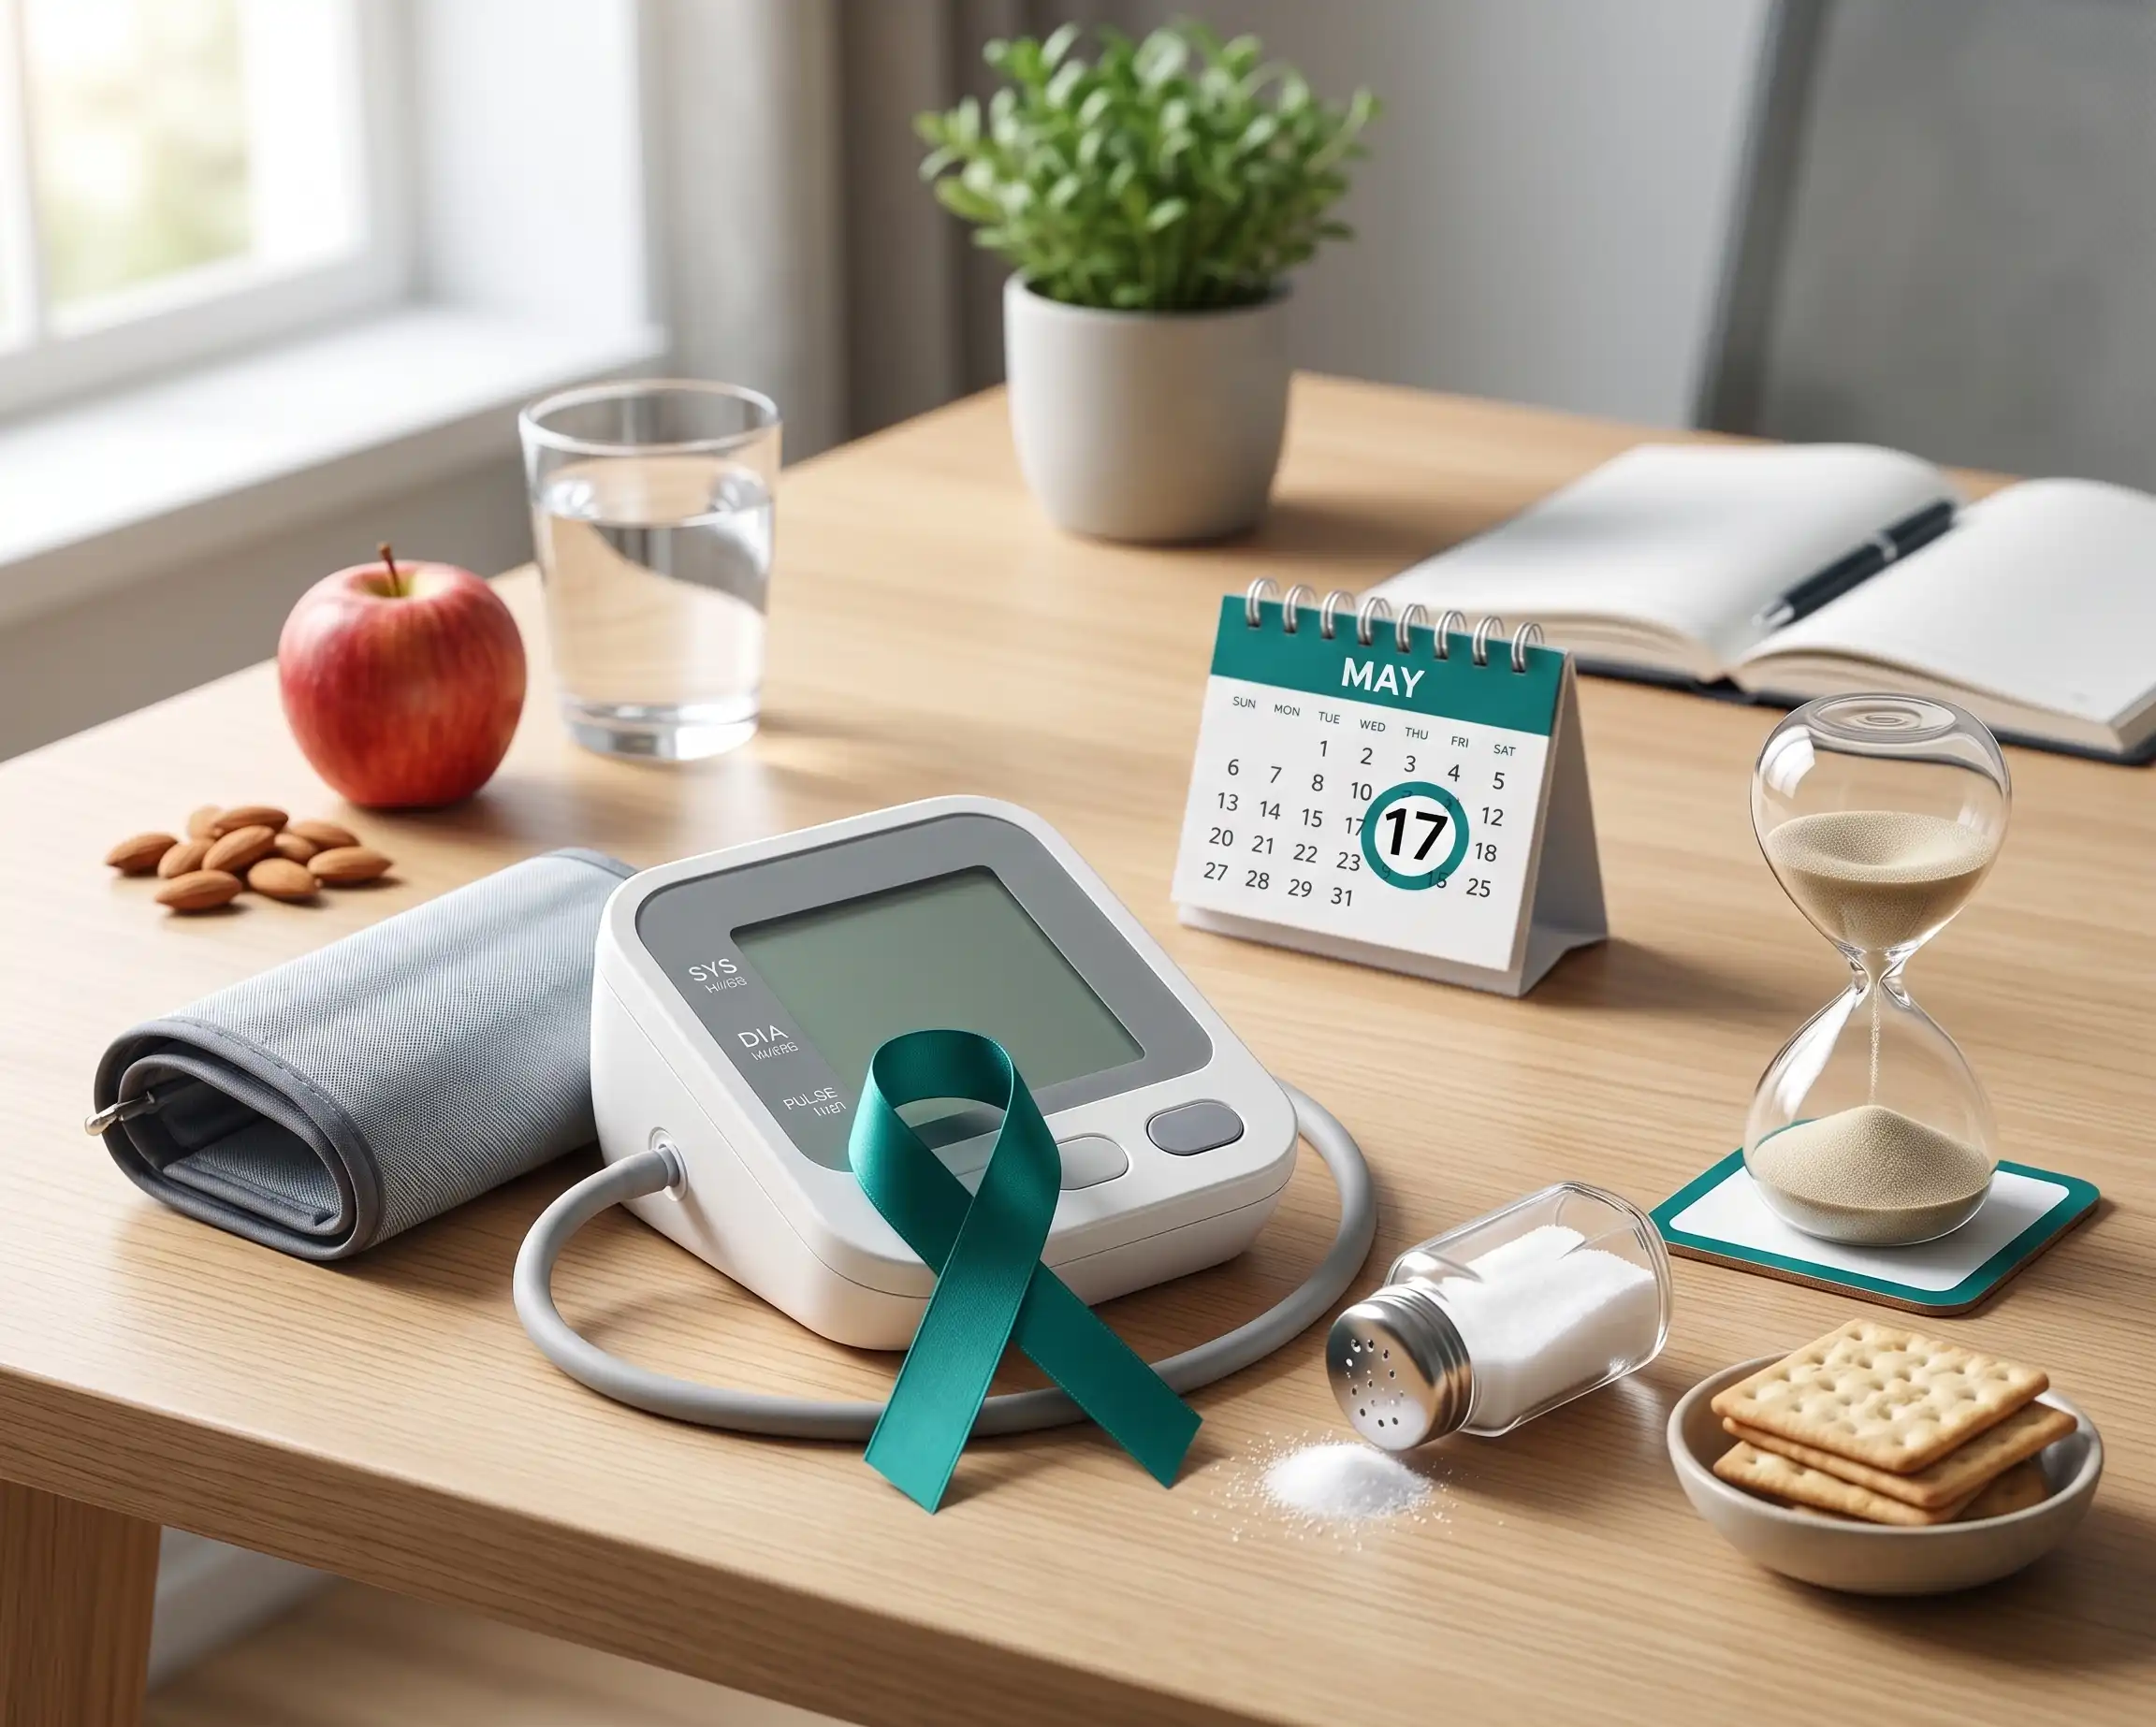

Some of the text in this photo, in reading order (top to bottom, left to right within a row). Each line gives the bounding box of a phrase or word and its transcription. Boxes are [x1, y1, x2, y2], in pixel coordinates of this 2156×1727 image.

[1341, 657, 1425, 698] MAY
[1232, 696, 1517, 757] SUN MON TUE WED THU FRI SAT
[1319, 740, 1506, 791] 1 2 3 4 5
[1228, 759, 1504, 829] 6 7 8 10 12
[1217, 791, 1239, 812] 13
[1260, 800, 1281, 820] 14
[1302, 807, 1323, 828] 15
[1385, 807, 1449, 861] 17
[1475, 842, 1497, 863] 18
[1203, 862, 1353, 907] 27 28 29 31
[1208, 826, 1234, 848] 20
[1251, 834, 1274, 855] 21
[1292, 843, 1318, 864] 22
[1336, 851, 1361, 872] 23
[1465, 878, 1492, 898] 25
[689, 958, 737, 981] SYS
[737, 1024, 789, 1048] DIA
[782, 1087, 838, 1110] PULSE
